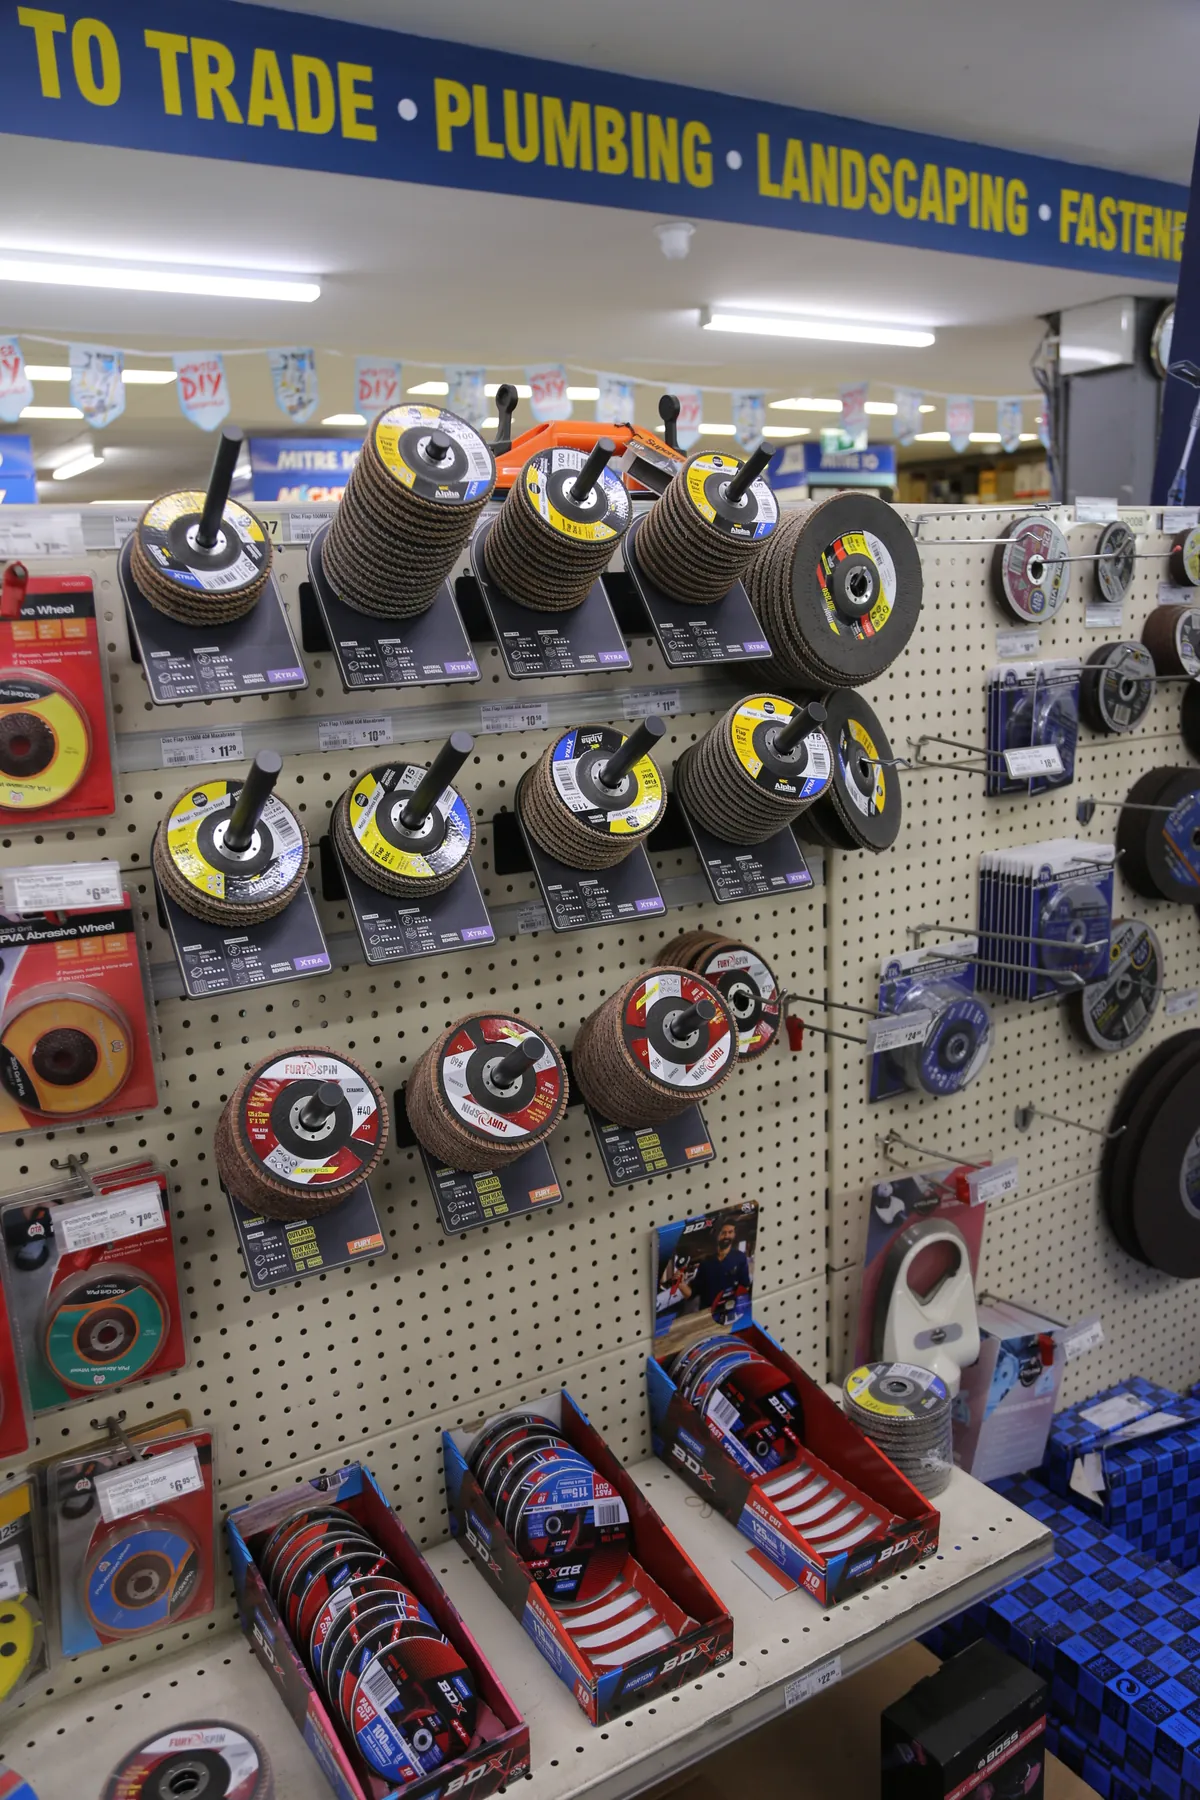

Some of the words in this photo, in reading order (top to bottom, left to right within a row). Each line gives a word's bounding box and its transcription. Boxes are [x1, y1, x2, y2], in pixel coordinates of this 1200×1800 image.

[17, 6, 121, 107] TO
[144, 29, 378, 142] TRADE
[434, 77, 714, 188] PLUMBING
[757, 133, 1029, 236] LANDSCAPING
[180, 373, 222, 400] DIY
[359, 379, 398, 401] DIY
[530, 380, 566, 399] DIY
[278, 451, 338, 470] MITRE
[37, 604, 75, 615] Wheel
[274, 671, 298, 680] XTRA
[581, 733, 603, 743] Alpha
[565, 739, 574, 759] XTRA
[402, 768, 415, 785] 115
[774, 783, 797, 792] Alpha
[804, 779, 815, 794] XTRA
[572, 803, 588, 811] 115
[92, 888, 100, 900] 6
[640, 900, 659, 908] XTRA
[0, 934, 25, 944] PVA
[26, 927, 77, 940] Abrasive
[79, 922, 115, 933] Wheel
[467, 930, 488, 938] XTRA
[300, 958, 324, 967] XTRA
[717, 959, 730, 968] FURY
[735, 957, 748, 966] SPIN
[450, 1056, 463, 1068] #60
[709, 1047, 724, 1062] FURY
[284, 1064, 306, 1075] FURY
[317, 1064, 338, 1075] SPIN
[692, 1064, 707, 1081] SPIN
[357, 1106, 371, 1116] #40
[461, 1102, 479, 1118] SPIN
[486, 1116, 508, 1132] FURY
[91, 1209, 108, 1218] Wheel
[137, 1214, 143, 1227] 7
[288, 1227, 314, 1239] OUTLASTS
[683, 1218, 716, 1234] BDX
[292, 1245, 303, 1254] LOW
[303, 1242, 317, 1251] HEAT
[353, 1238, 371, 1249] FURY
[768, 1395, 795, 1423] BDX
[708, 1423, 723, 1440] FAST
[671, 1443, 716, 1492] BDX
[174, 1480, 183, 1491] 6
[595, 1483, 609, 1491] CUT
[595, 1487, 613, 1497] FAST
[752, 1500, 768, 1518] FAST
[768, 1514, 782, 1529] CUT
[878, 1531, 927, 1562] BDX
[465, 1531, 503, 1583] BDX
[547, 1564, 582, 1578] BDX
[805, 1570, 820, 1589] 10
[252, 1624, 285, 1677] BDX
[660, 1636, 715, 1675] BDX
[626, 1671, 654, 1689] NORTON
[437, 1680, 467, 1715] BDX
[577, 1684, 590, 1705] 10
[356, 1706, 370, 1722] CUT
[359, 1697, 375, 1716] FAST
[169, 1736, 194, 1748] FURY
[203, 1733, 226, 1744] SPIN
[986, 1731, 1019, 1763] BOSS
[444, 1748, 514, 1798] BDX
